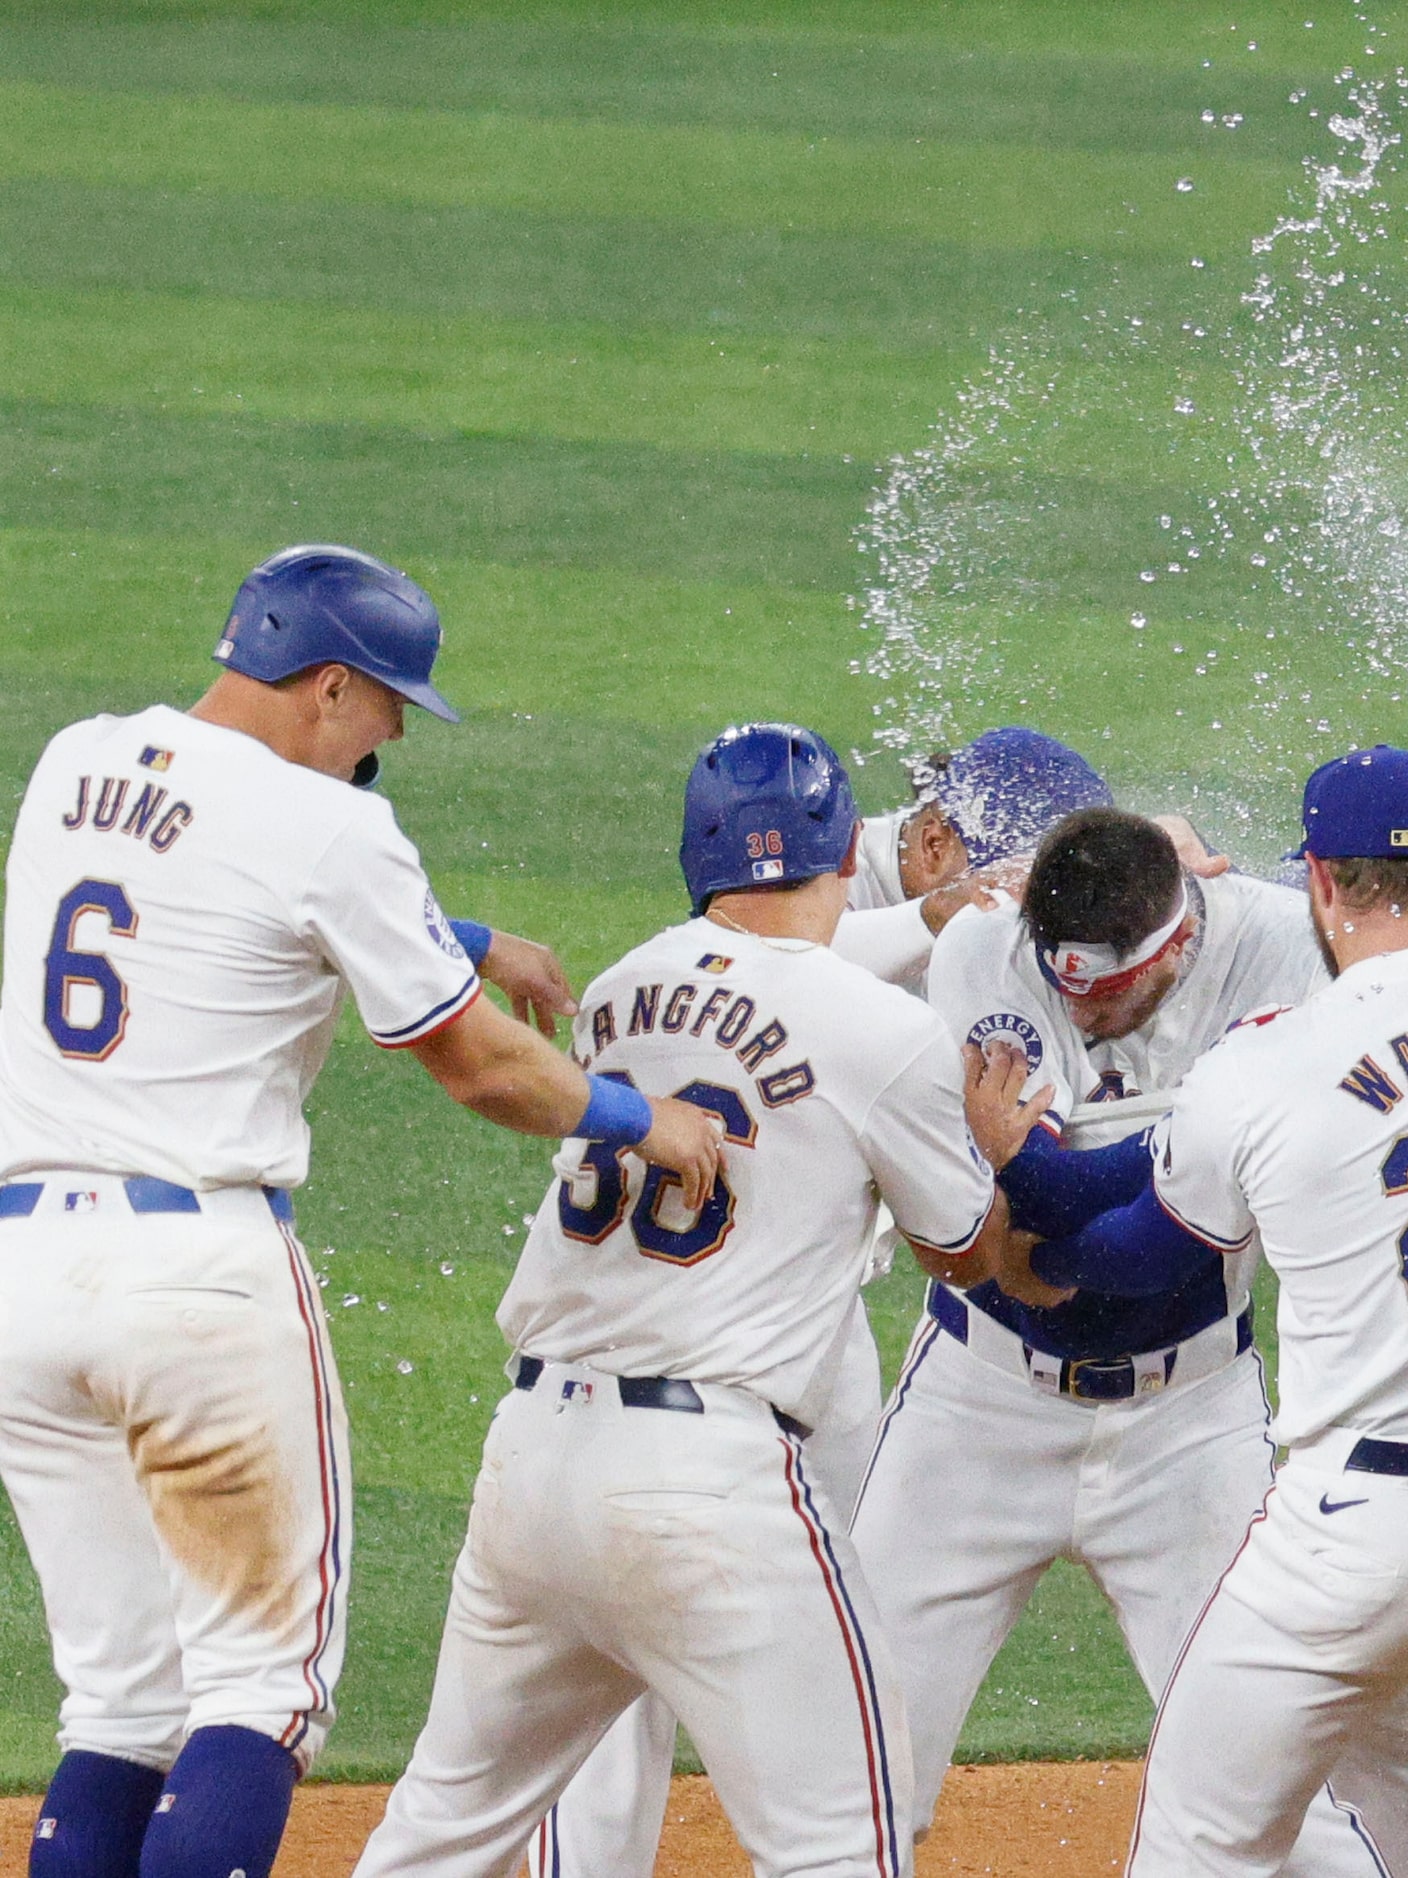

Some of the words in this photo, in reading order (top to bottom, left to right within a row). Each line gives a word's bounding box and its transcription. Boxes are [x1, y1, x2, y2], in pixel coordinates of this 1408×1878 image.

[62, 775, 194, 854] JUNG
[746, 830, 783, 858] 36
[42, 875, 139, 1063] 6
[969, 1014, 1041, 1043] ENERGY
